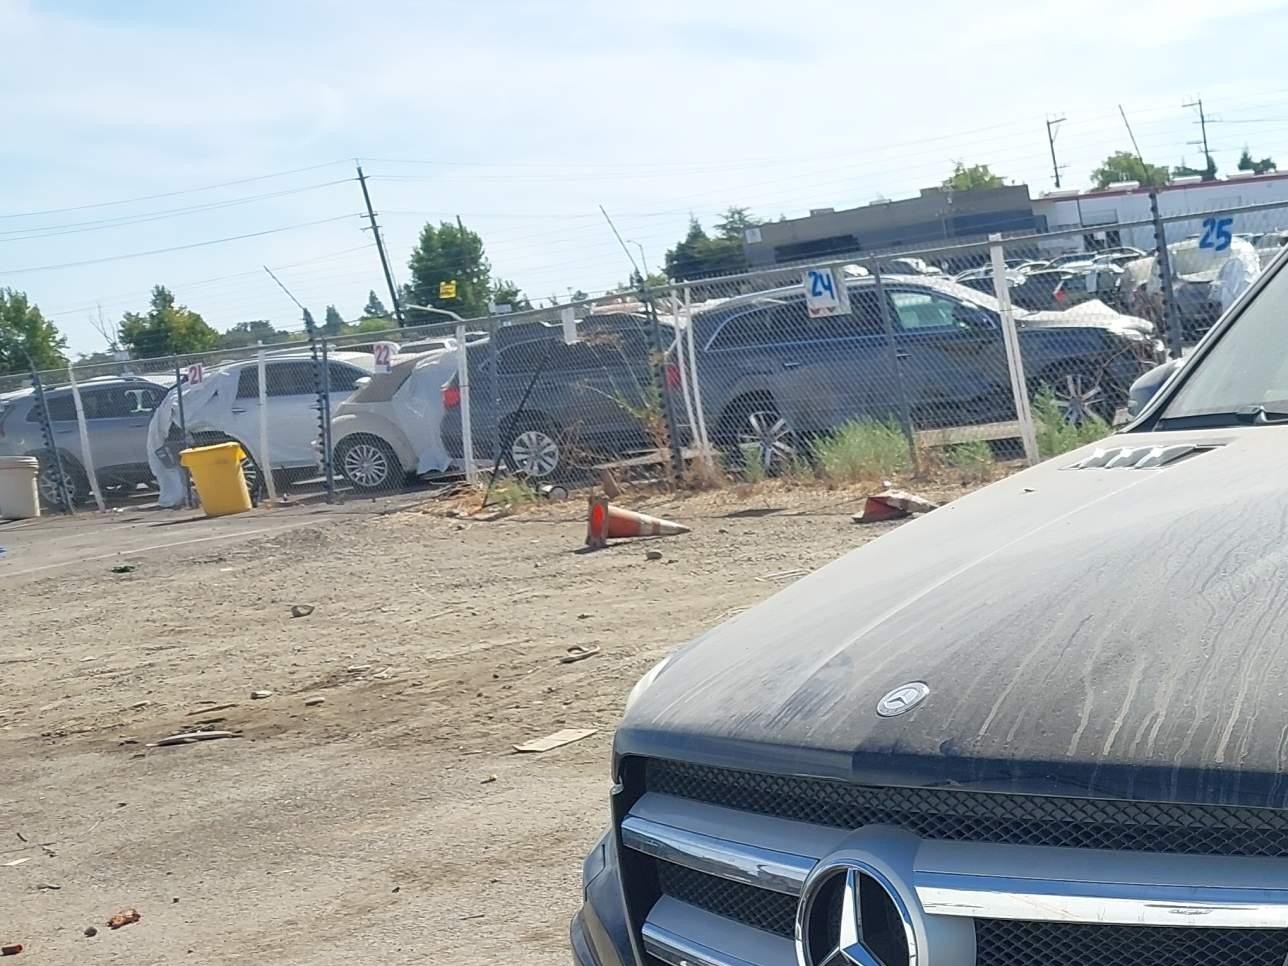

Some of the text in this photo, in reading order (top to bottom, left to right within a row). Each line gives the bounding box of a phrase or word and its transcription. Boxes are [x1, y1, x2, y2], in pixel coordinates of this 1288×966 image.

[1199, 217, 1233, 251] 25
[808, 271, 835, 300] 24
[376, 345, 390, 365] 22
[190, 365, 202, 385] 21
